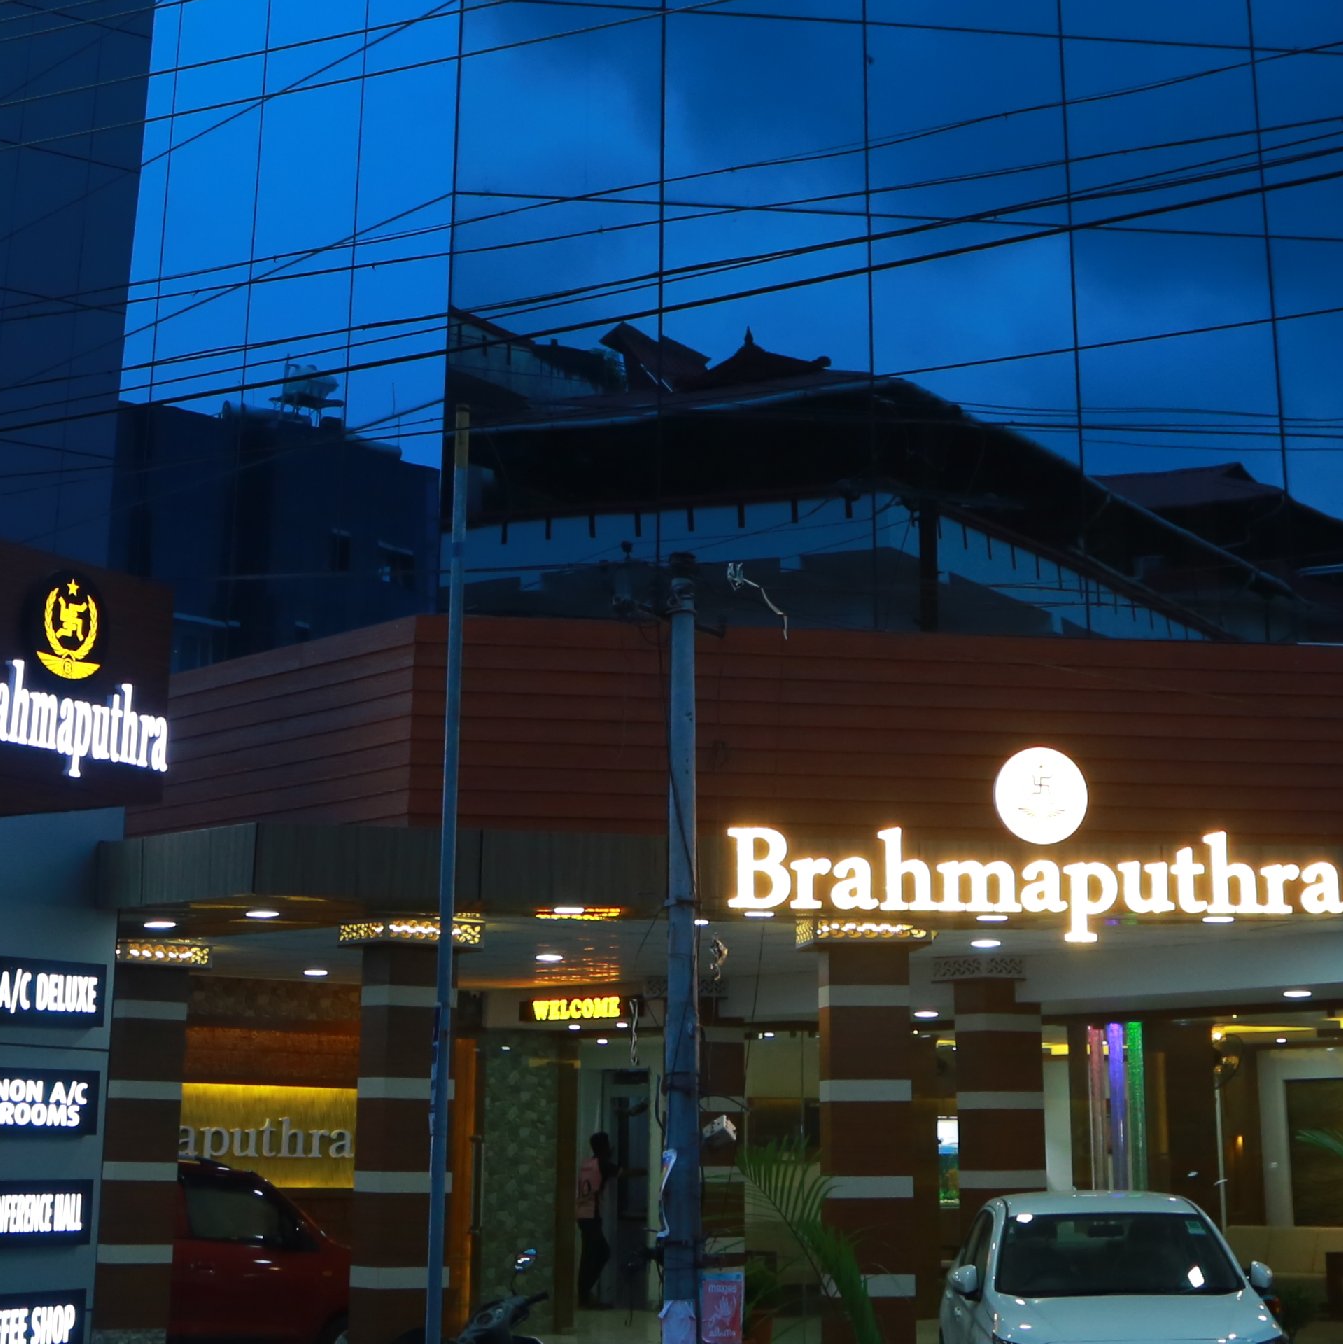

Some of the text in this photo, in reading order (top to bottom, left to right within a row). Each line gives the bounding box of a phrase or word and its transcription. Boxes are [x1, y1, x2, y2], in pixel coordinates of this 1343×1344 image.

[35, 971, 98, 1014] DELUXE
[532, 996, 621, 1022] WELCOME
[49, 1080, 89, 1106] A/C
[53, 1193, 82, 1232] HALL
[30, 1304, 76, 1344] SHOP
